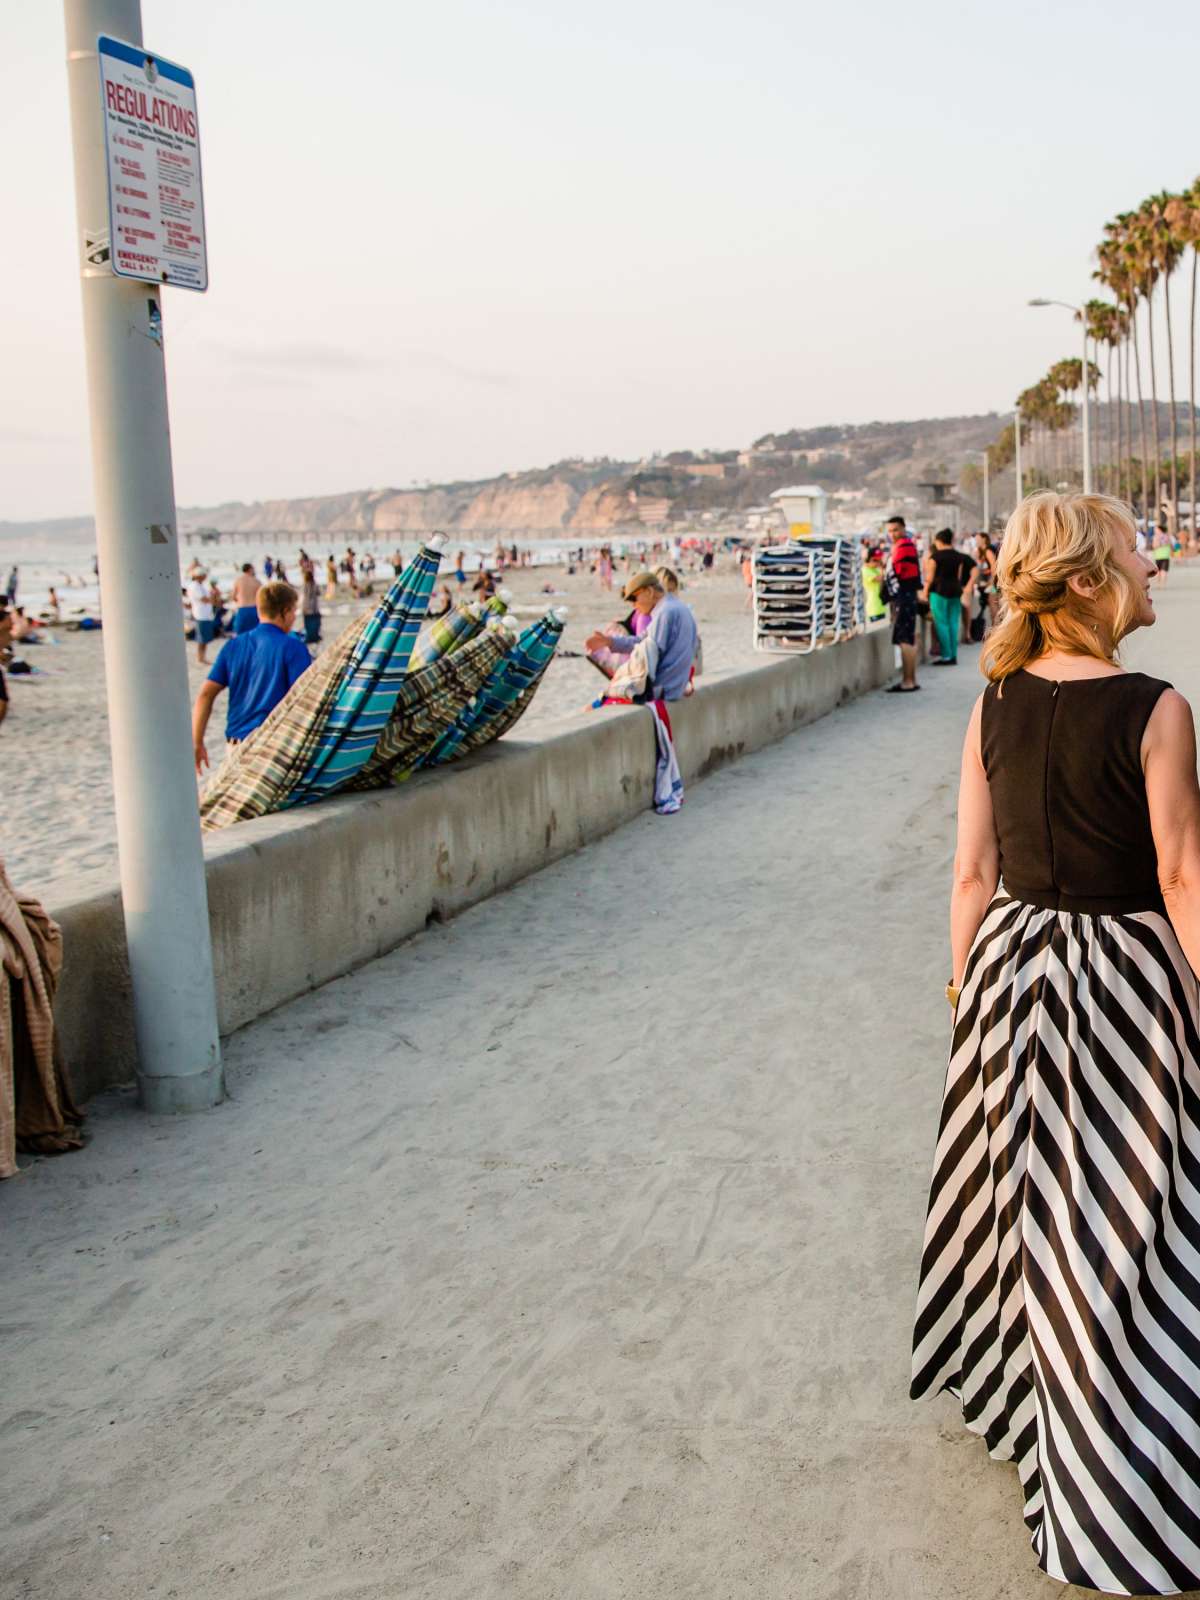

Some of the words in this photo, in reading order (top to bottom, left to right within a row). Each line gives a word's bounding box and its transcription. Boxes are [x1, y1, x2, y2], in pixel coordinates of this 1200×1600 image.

[106, 80, 196, 138] REGULATIONS
[118, 250, 159, 264] EMERGENCY
[120, 260, 136, 270] CALL
